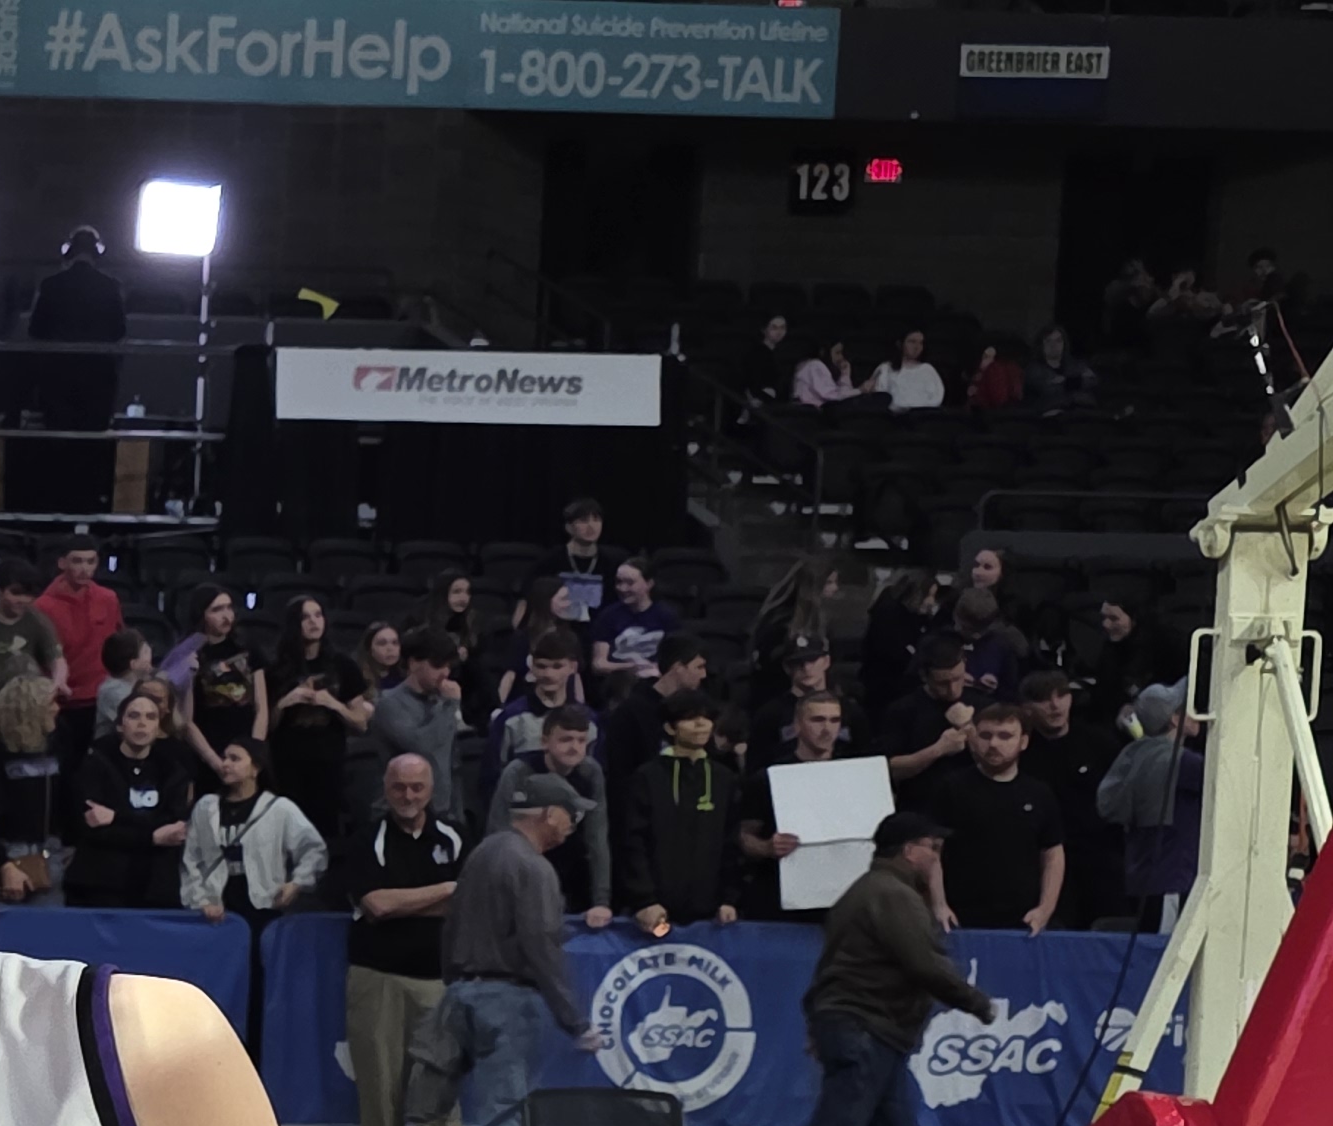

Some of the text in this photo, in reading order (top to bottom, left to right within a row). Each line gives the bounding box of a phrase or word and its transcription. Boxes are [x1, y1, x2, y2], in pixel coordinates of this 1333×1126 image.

[480, 13, 829, 43] National Suicide Prevention Lifeline
[44, 8, 452, 95] #AskForHelp
[966, 50, 1103, 74] GREENBRIER EAST
[479, 48, 824, 103] 1-800-273-TALK
[796, 162, 850, 201] 123
[394, 366, 583, 395] MetroNews
[687, 955, 733, 991] MILK
[641, 1024, 716, 1048] SSAC
[927, 1034, 1063, 1076] SSAC
